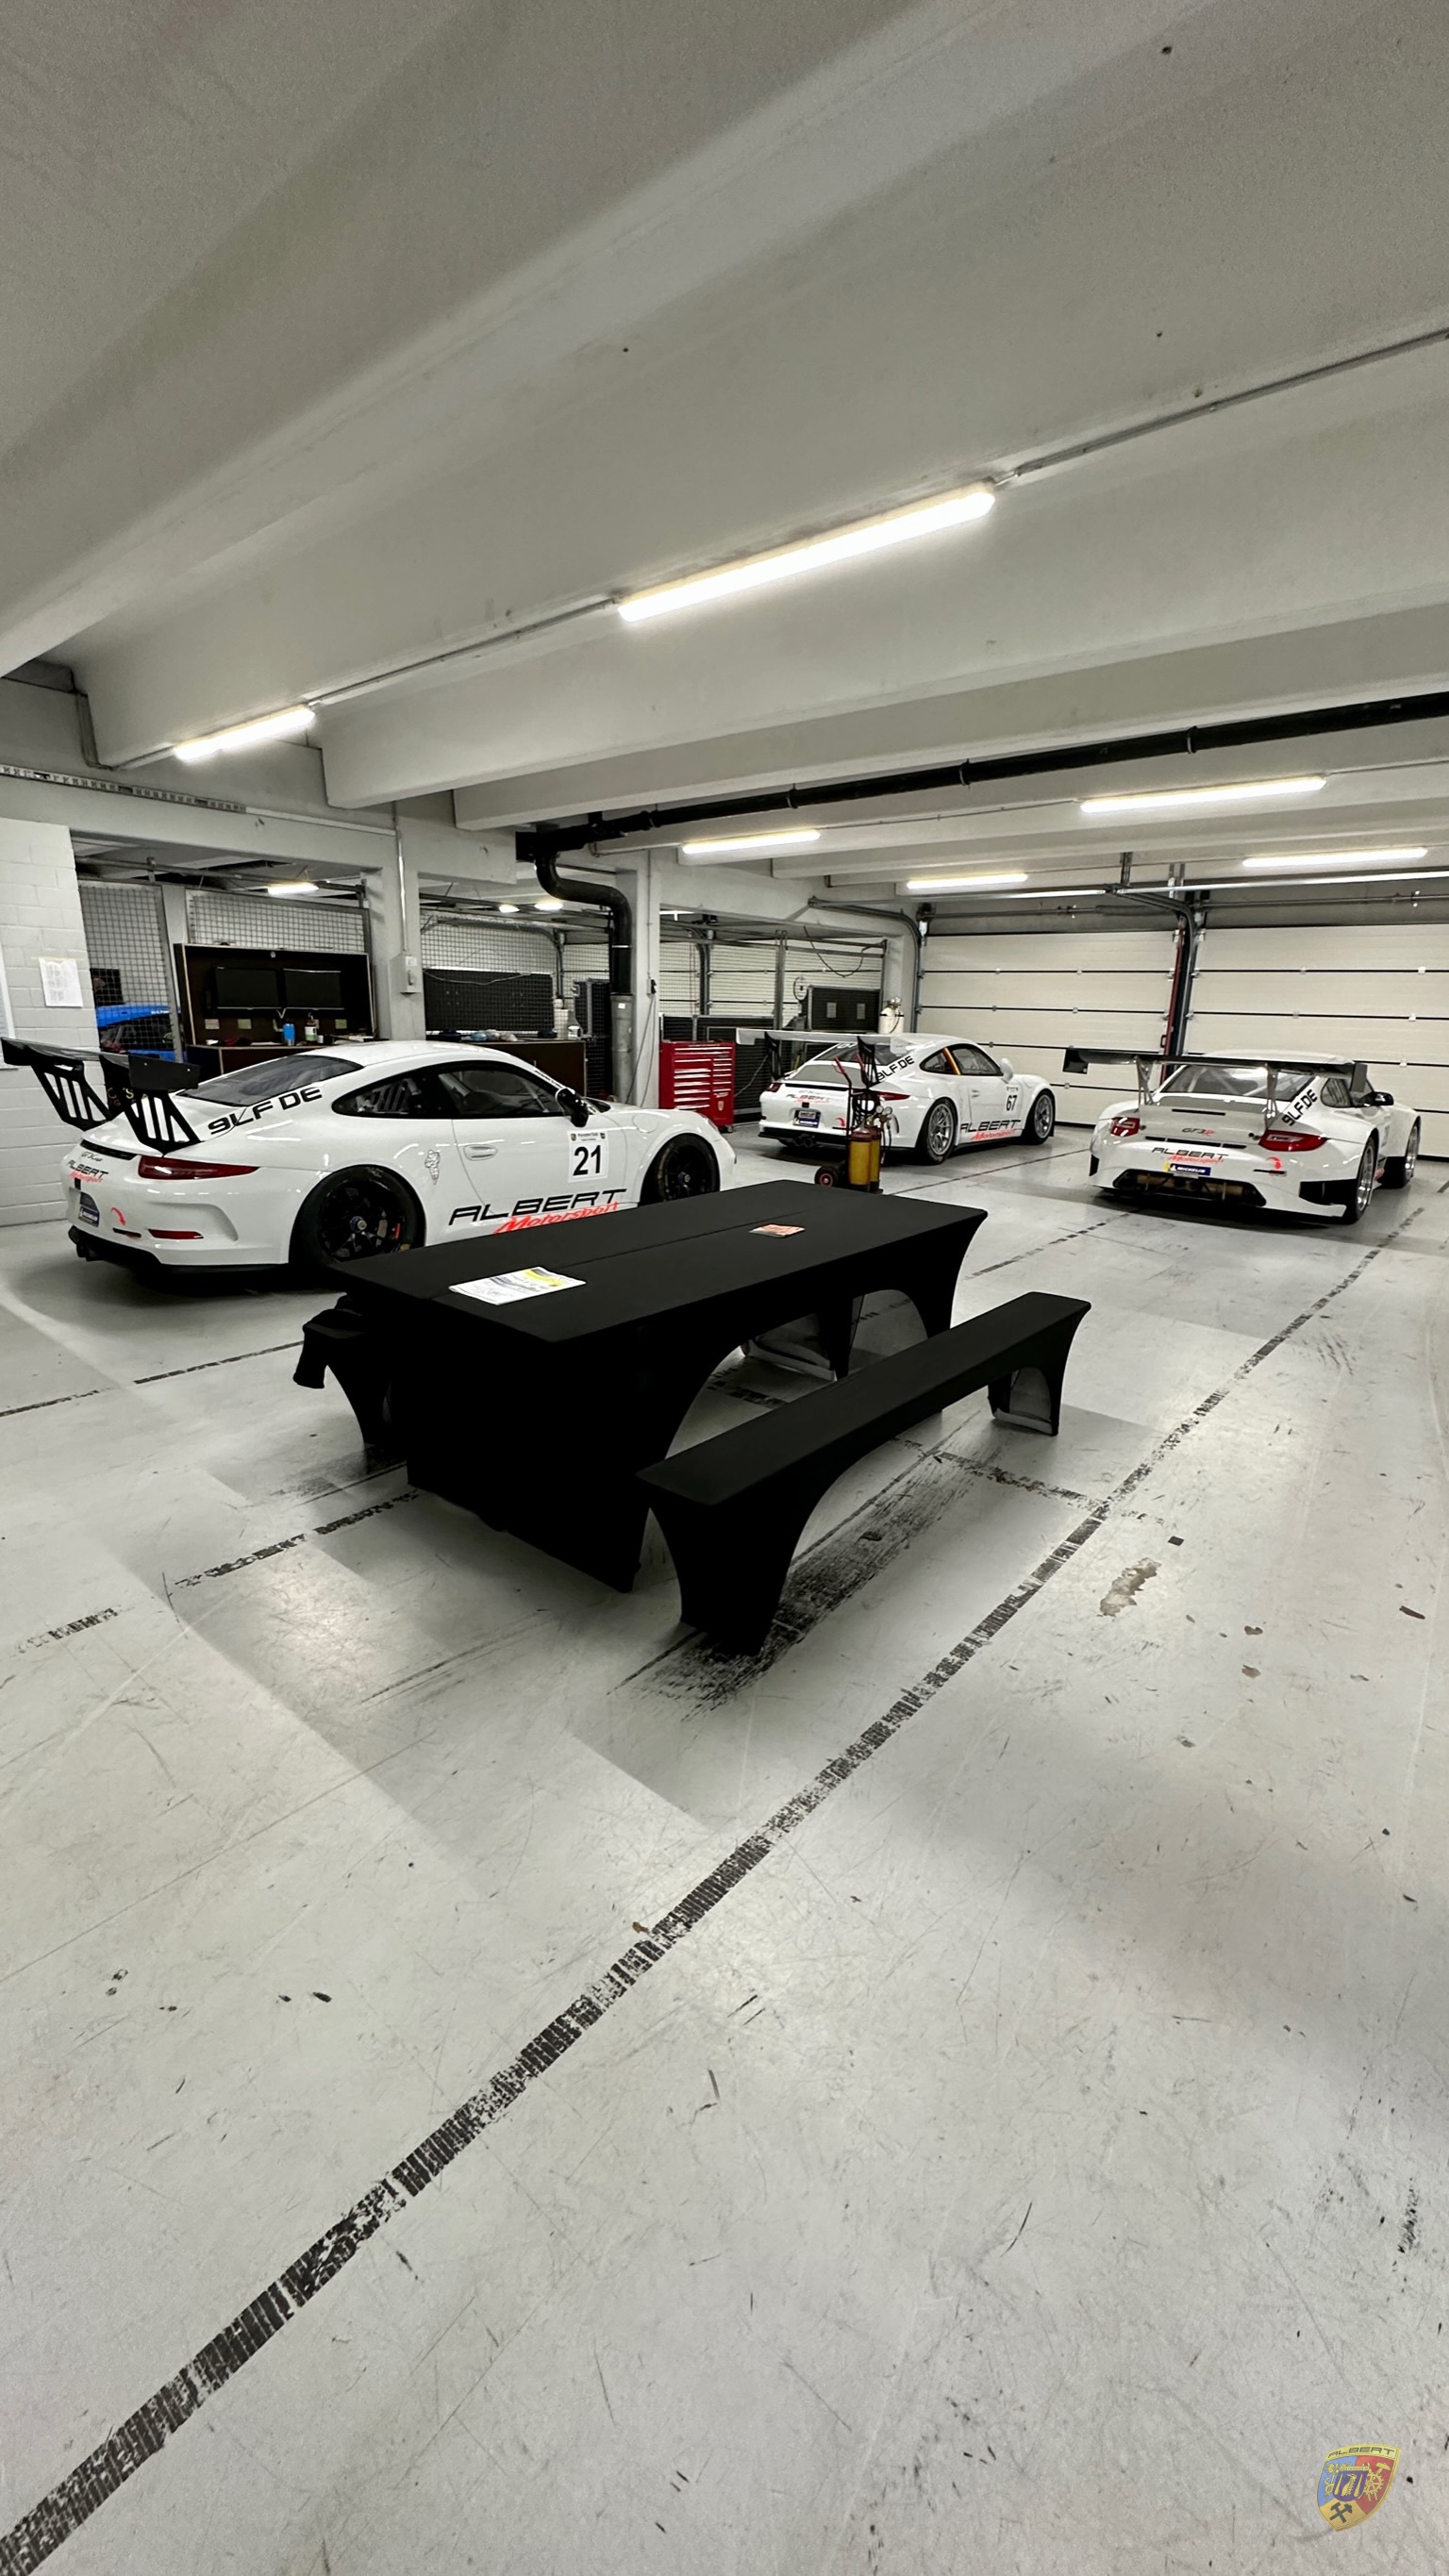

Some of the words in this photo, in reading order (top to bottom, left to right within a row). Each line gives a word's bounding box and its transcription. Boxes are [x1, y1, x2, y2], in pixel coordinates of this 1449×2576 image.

[1006, 1094, 1018, 1111] 67
[960, 1119, 1022, 1134] ALBERT
[573, 1144, 601, 1176] 21
[1151, 1146, 1229, 1160] ALBERT
[67, 1159, 109, 1180] ALBERT
[448, 1188, 627, 1226] ALBERT
[492, 1201, 620, 1235] Motorsport
